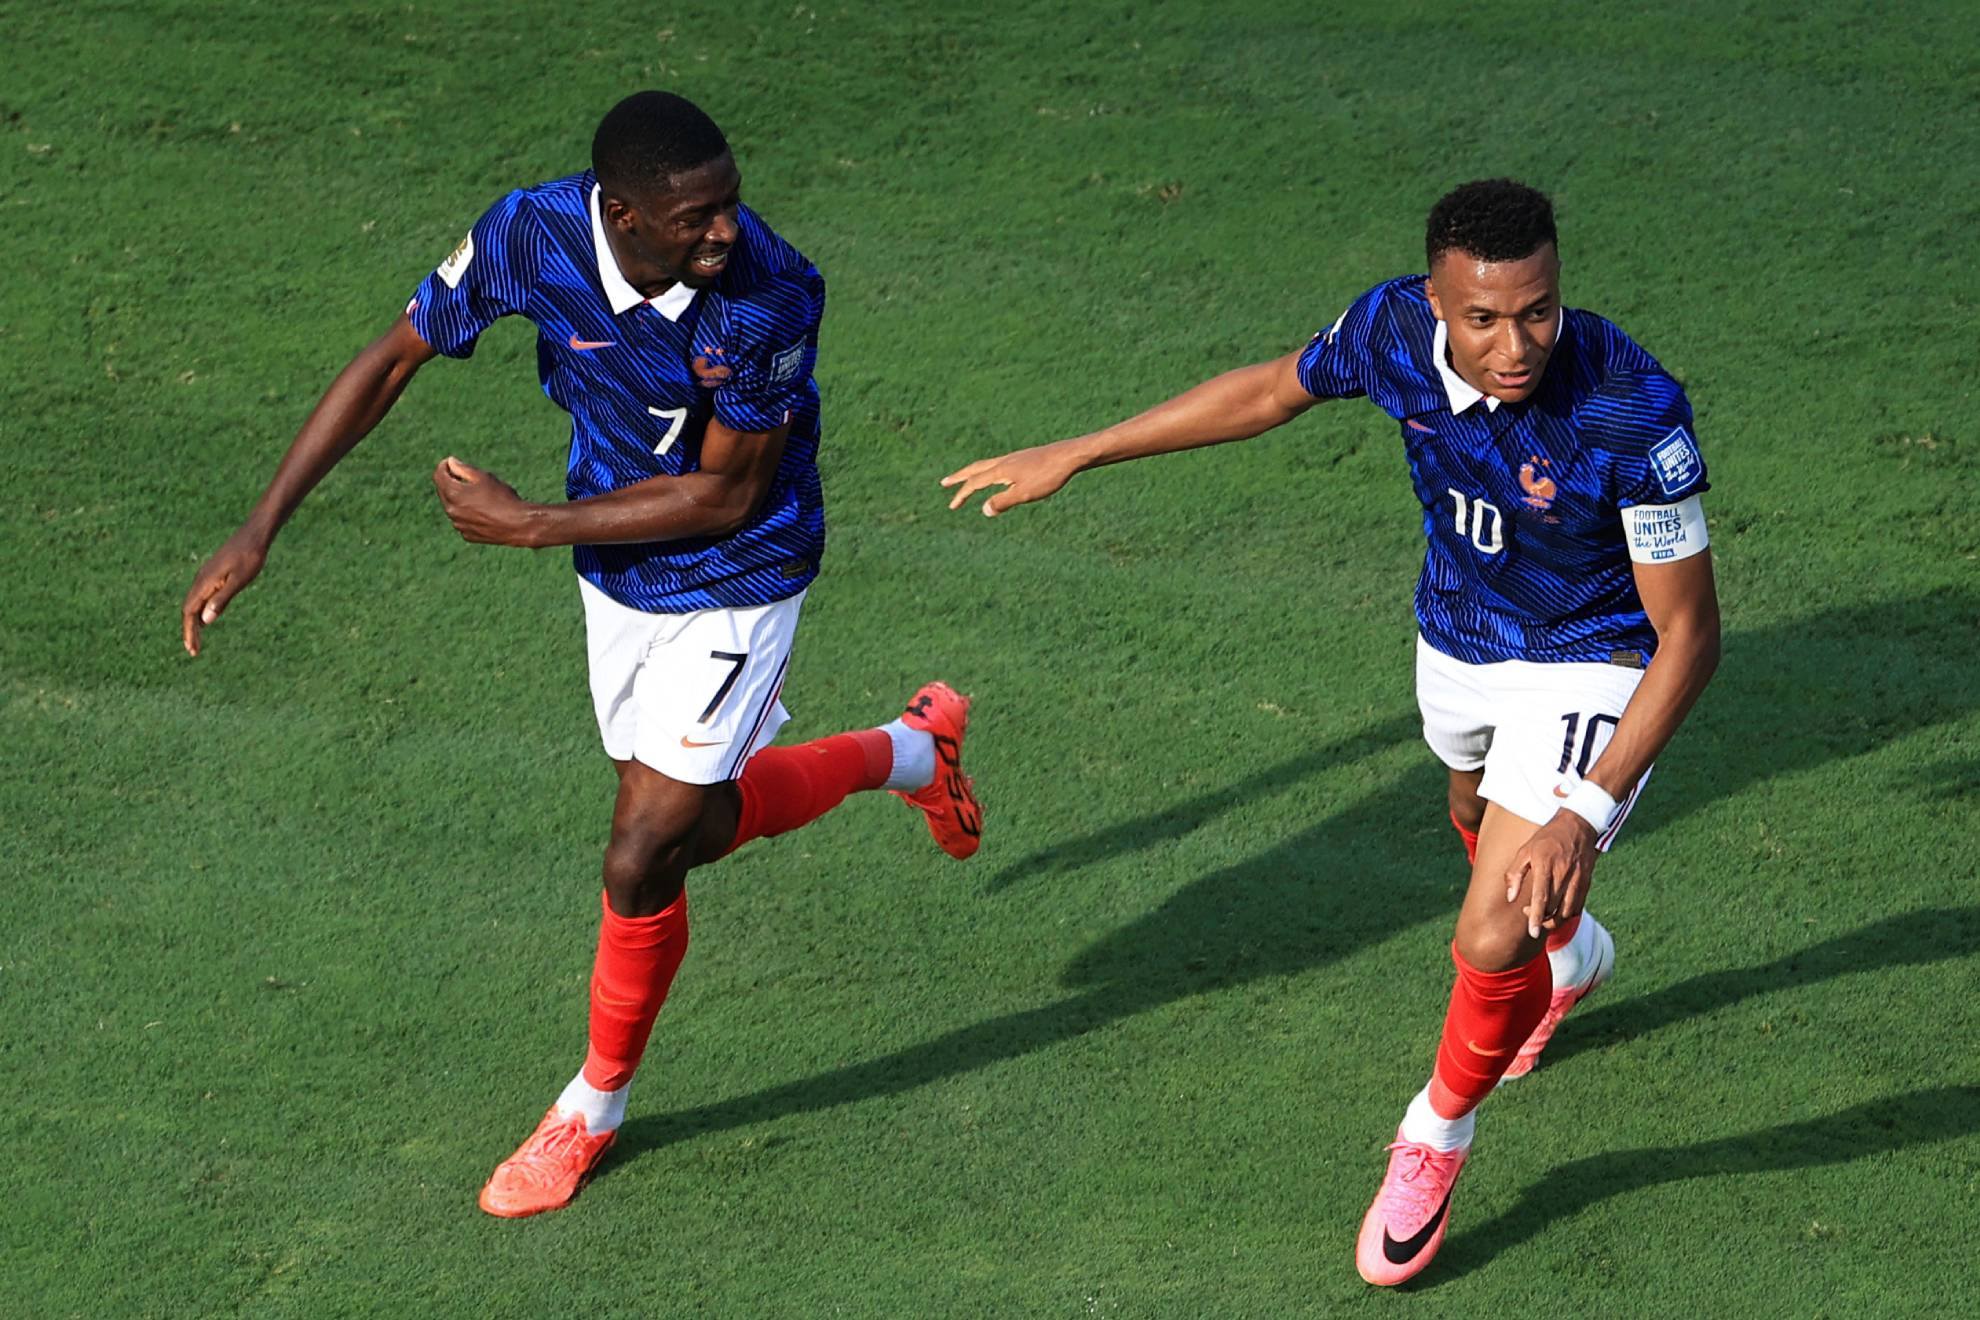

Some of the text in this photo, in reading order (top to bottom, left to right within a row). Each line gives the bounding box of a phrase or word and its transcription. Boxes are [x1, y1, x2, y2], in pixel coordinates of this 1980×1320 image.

[648, 406, 687, 455] 7
[1661, 444, 1690, 471] UNITES
[1448, 487, 1504, 554] 10
[1634, 508, 1680, 520] FOOTBALL
[1634, 517, 1682, 535] UNITES
[1633, 530, 1687, 548] the World
[1652, 549, 1674, 559] FIFA
[696, 650, 749, 724] 7
[1557, 712, 1620, 780] 10
